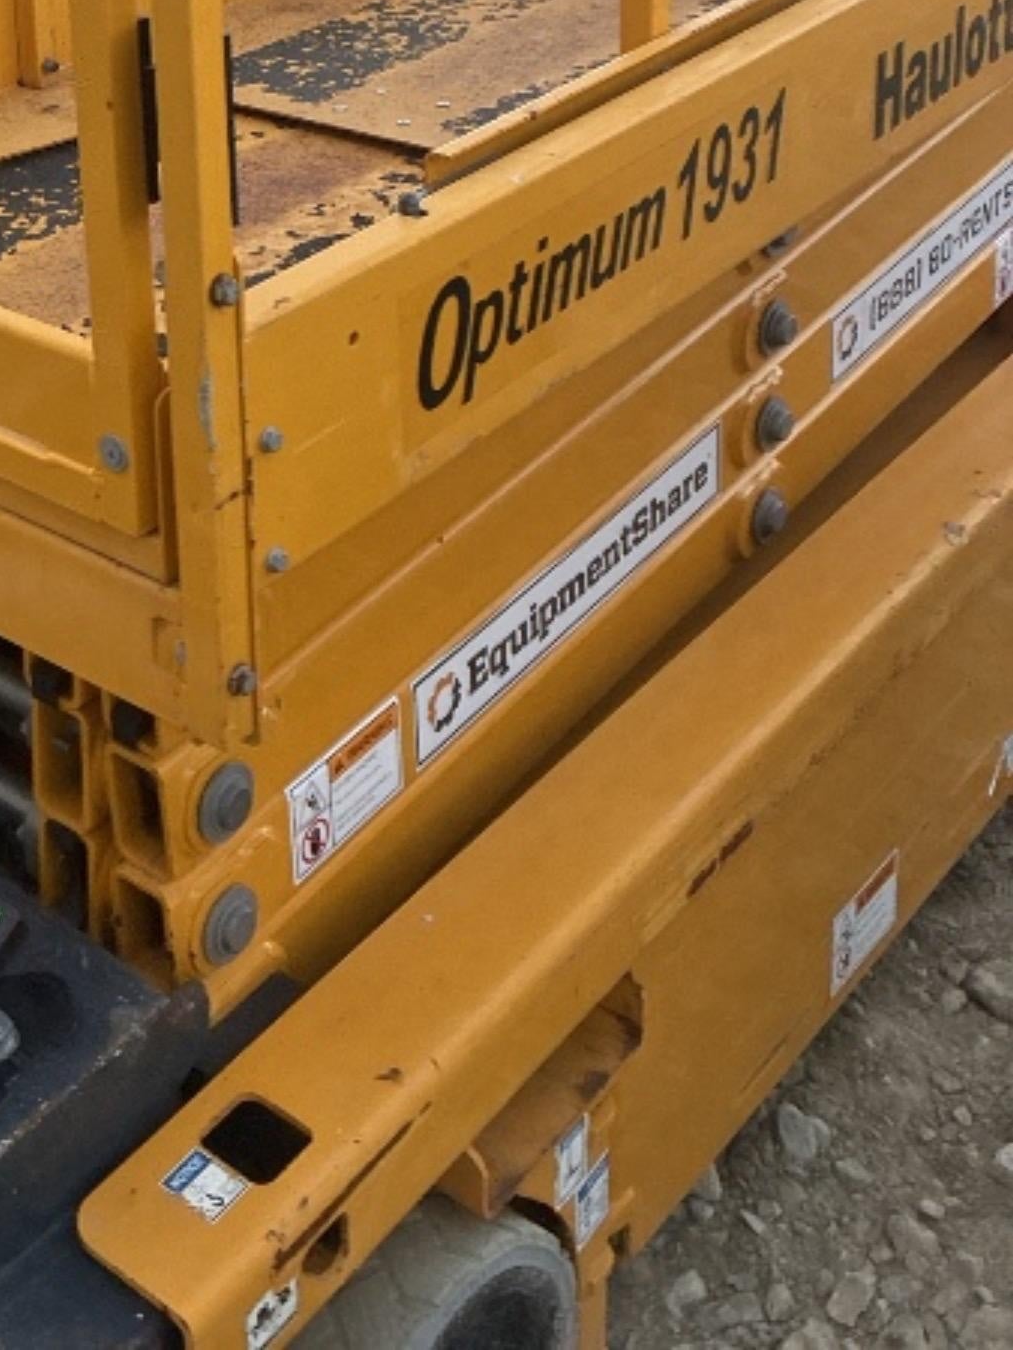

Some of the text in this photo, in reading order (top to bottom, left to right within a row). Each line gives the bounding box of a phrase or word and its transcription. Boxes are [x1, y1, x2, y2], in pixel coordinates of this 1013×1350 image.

[417, 87, 788, 411] Optimum 1931
[467, 460, 710, 697] EquipmentShare
